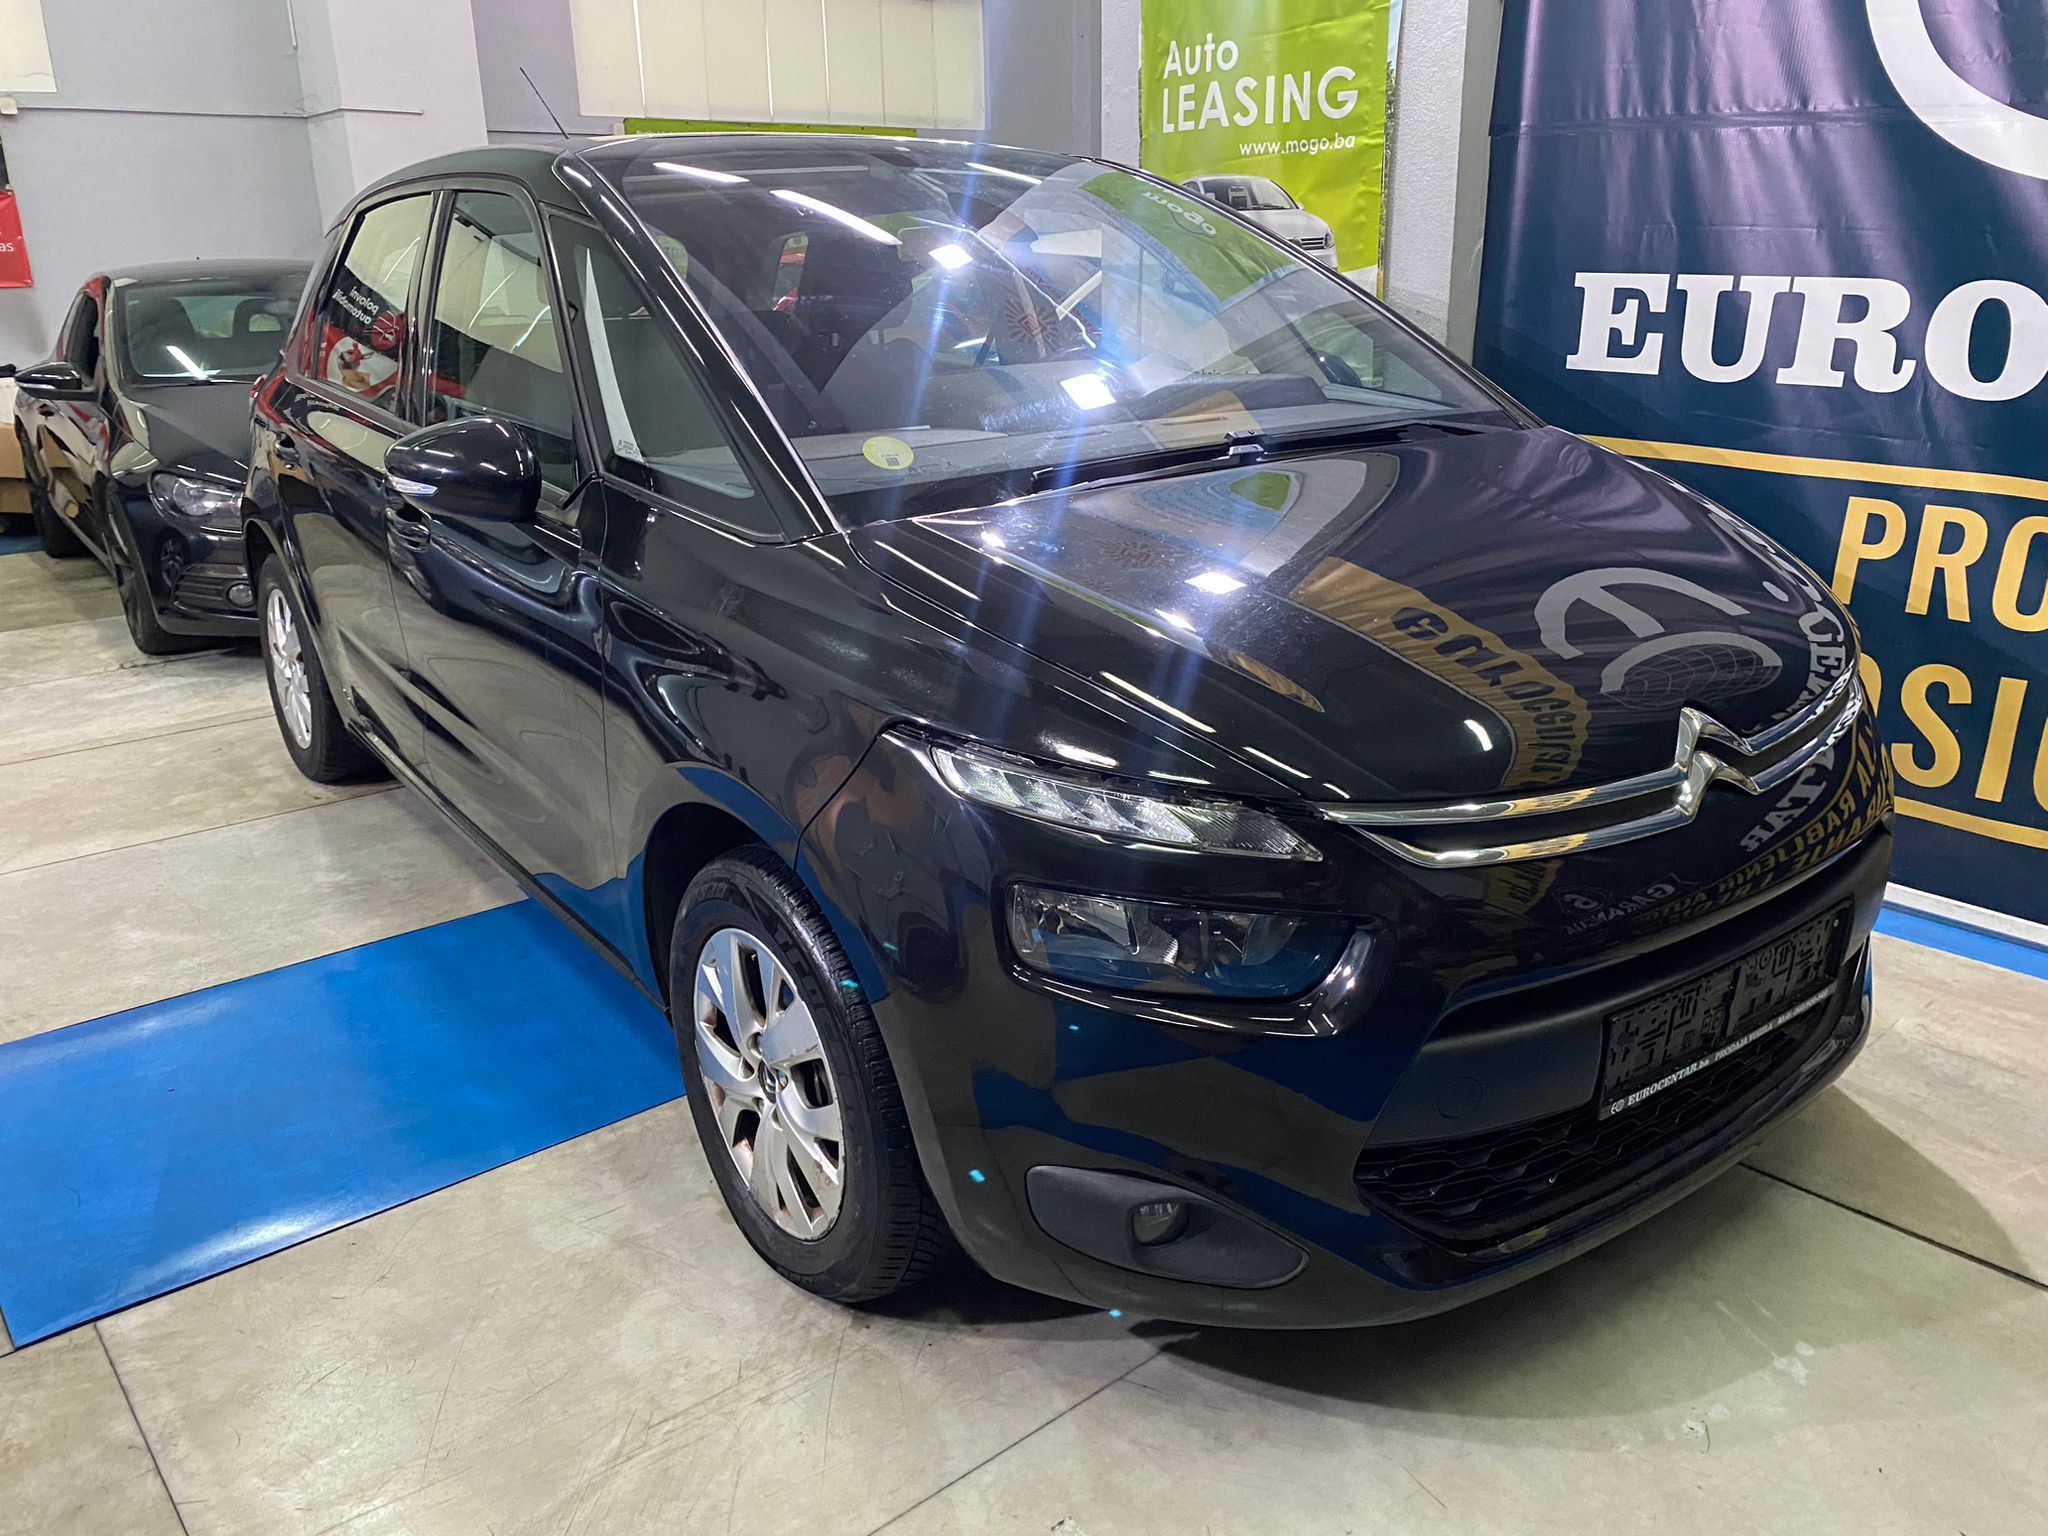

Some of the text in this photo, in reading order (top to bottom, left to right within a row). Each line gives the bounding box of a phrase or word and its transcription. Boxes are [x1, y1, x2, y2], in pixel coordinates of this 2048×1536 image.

[1163, 33, 1239, 79] Auto
[1162, 66, 1359, 134] LEASING
[1239, 133, 1356, 156] www.mogo.ba
[1565, 271, 2048, 402] EURO
[1859, 653, 2048, 815] SI
